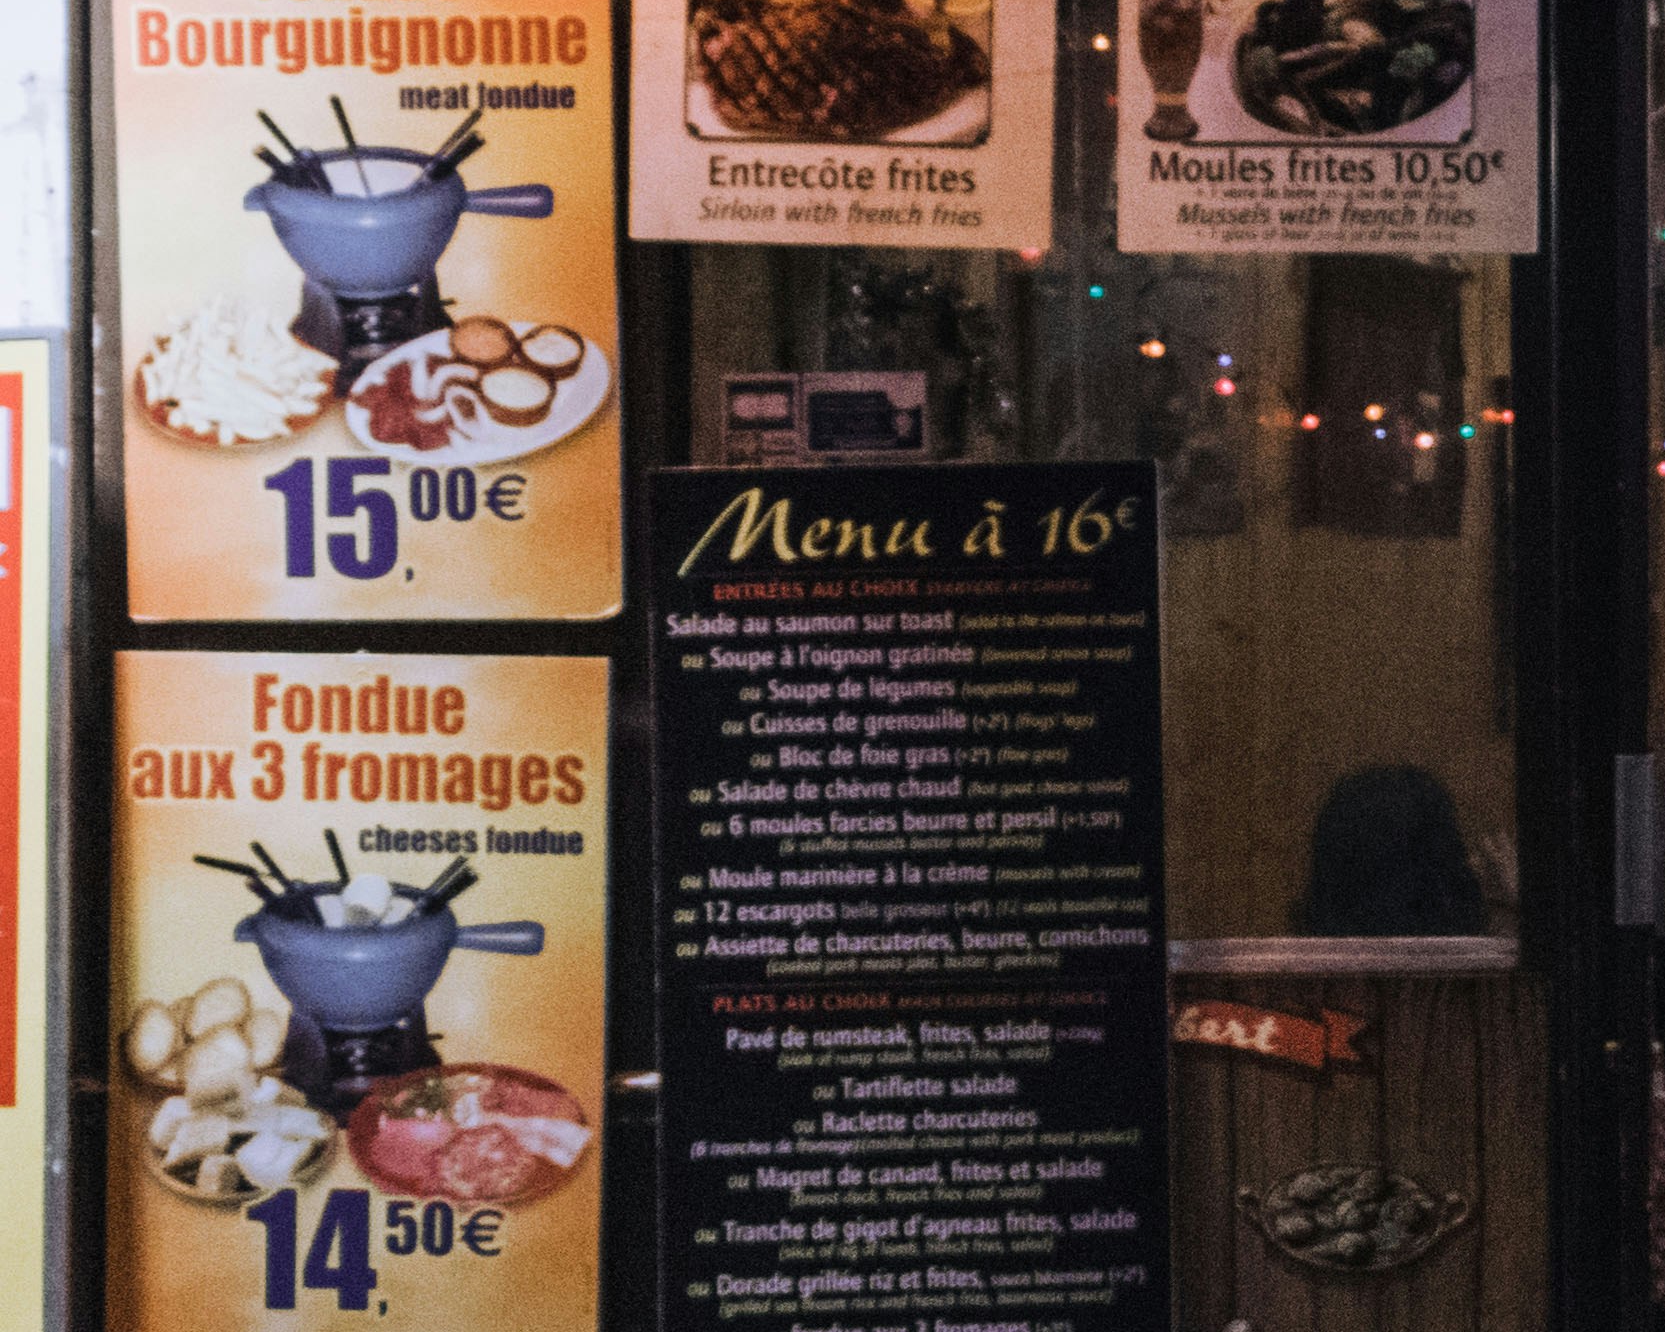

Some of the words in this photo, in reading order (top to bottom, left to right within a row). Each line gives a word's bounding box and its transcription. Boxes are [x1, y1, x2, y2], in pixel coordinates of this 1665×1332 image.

[137, 7, 587, 74] Bourguignonne
[399, 83, 469, 109] meat
[478, 82, 575, 110] fondue
[709, 155, 875, 191] Entrecôte
[888, 158, 976, 193] frites
[1150, 151, 1274, 183] Moules
[1288, 150, 1375, 183] frites
[699, 197, 775, 222] Sirloin
[785, 201, 838, 225] with
[848, 200, 921, 227] french
[931, 202, 982, 227] fries
[1177, 205, 1271, 225] Mussels
[1279, 203, 1330, 225] with
[1340, 203, 1418, 227] french
[1425, 204, 1476, 227] fries
[677, 486, 933, 579] Menu
[963, 500, 1007, 557] à
[1039, 488, 1141, 556] 16€
[812, 580, 845, 599] AU
[850, 579, 918, 598] CHOIX
[666, 611, 738, 636] Salade
[742, 616, 771, 634] au
[775, 615, 857, 634] saumon
[862, 614, 894, 632] sur
[899, 609, 954, 632] toast
[680, 653, 705, 669] ou
[709, 645, 776, 672] Soupe
[798, 642, 883, 671] l'oignon
[888, 640, 976, 670] gratinée
[254, 673, 465, 736] Fondue
[738, 686, 762, 702] ou
[767, 678, 832, 706] Soupe
[837, 677, 863, 699] de
[868, 675, 956, 704] légumes
[721, 719, 744, 736] ou
[749, 711, 827, 735] Cuisses
[832, 711, 859, 734] de
[863, 707, 968, 739] grenouille
[749, 752, 773, 768] ou
[778, 744, 824, 768] Bloc
[827, 744, 855, 766] de
[859, 742, 899, 766] foie
[904, 746, 950, 770] gras
[132, 748, 236, 801] aux
[252, 741, 285, 802] 3
[301, 741, 585, 812] fromages
[688, 788, 713, 804] ou
[716, 779, 789, 804] Salade
[792, 779, 820, 801] de
[897, 775, 961, 799] chaud
[700, 821, 724, 837] ou
[728, 813, 745, 837] 6
[749, 813, 825, 836] moules
[829, 809, 898, 834] farcies
[902, 808, 968, 831] beurre
[974, 810, 997, 830] et
[1001, 805, 1057, 833] persil
[359, 827, 478, 854] cheeses
[485, 827, 584, 855] fondue
[679, 875, 704, 891] ou
[708, 866, 775, 889] Moule
[901, 861, 922, 885] la
[673, 909, 697, 925] ou
[703, 899, 732, 924] 12
[735, 900, 837, 928] escargots
[675, 943, 700, 959] ou
[703, 932, 789, 957] Assiette
[793, 931, 821, 954] de
[1038, 923, 1150, 948] cornichons
[724, 1025, 776, 1051] Pavé
[779, 1025, 807, 1049] de
[983, 1018, 1051, 1043] salade
[1173, 1006, 1277, 1054] bert
[811, 1084, 836, 1101] ou
[840, 1074, 945, 1100] Tartiflette
[950, 1072, 1017, 1096] salade
[726, 1174, 751, 1190] ou
[755, 1164, 832, 1194] Magret
[836, 1162, 863, 1187] de
[949, 1158, 1004, 1182] frites
[1008, 1161, 1032, 1181] et
[1035, 1156, 1103, 1179] salade
